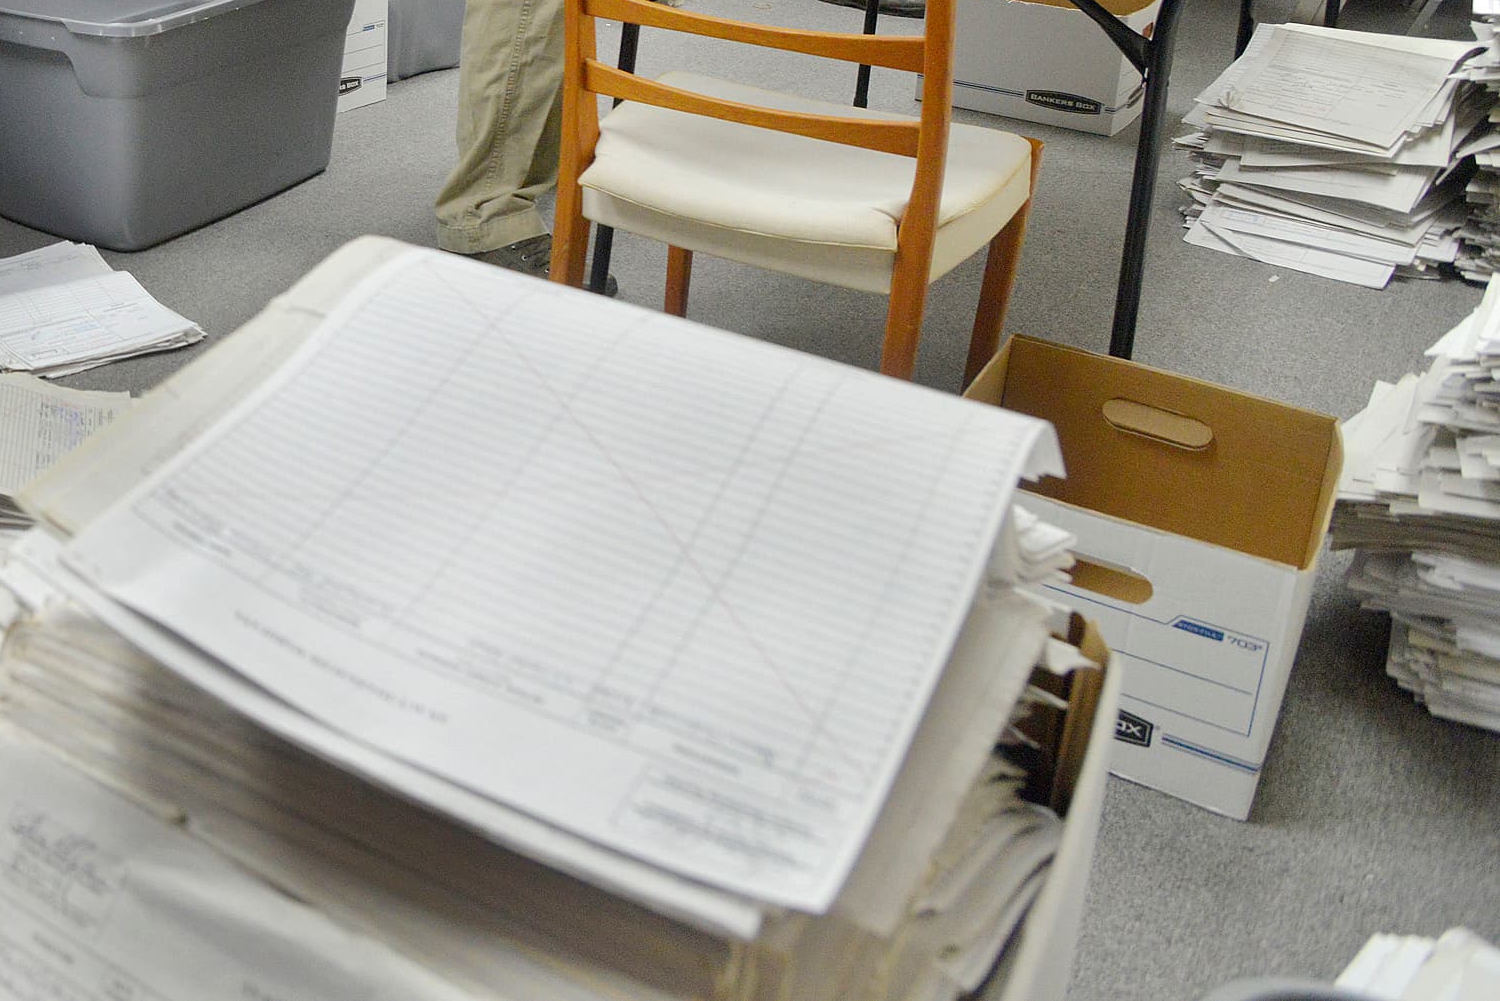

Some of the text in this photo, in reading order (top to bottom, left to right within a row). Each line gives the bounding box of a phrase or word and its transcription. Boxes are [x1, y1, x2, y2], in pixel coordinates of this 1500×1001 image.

[1030, 93, 1097, 111] BANKERS BOX
[1116, 719, 1142, 738] OX
